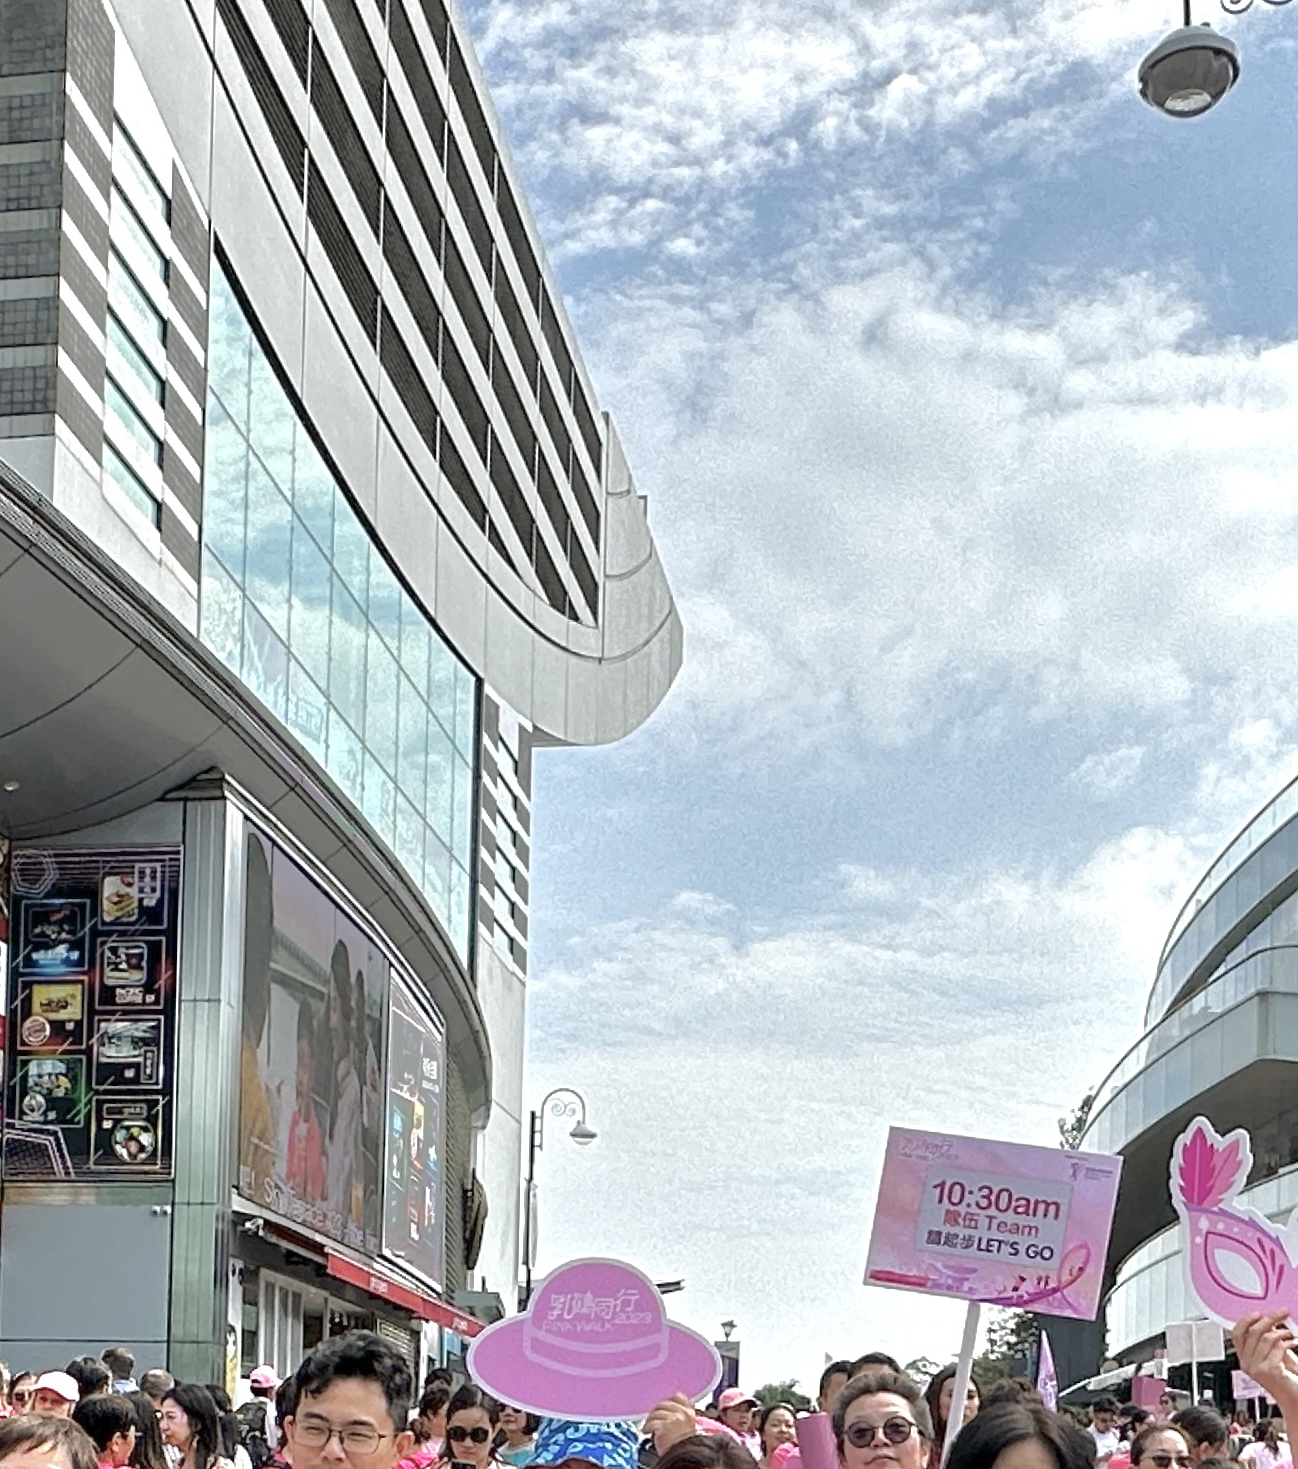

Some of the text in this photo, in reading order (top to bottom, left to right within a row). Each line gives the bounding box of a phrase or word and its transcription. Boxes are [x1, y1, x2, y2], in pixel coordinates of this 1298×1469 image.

[932, 1179, 1061, 1221] 10:30am
[986, 1213, 1040, 1238] Team
[977, 1235, 1020, 1257] LET'S
[1025, 1242, 1055, 1261] GO
[614, 1311, 652, 1325] 2023
